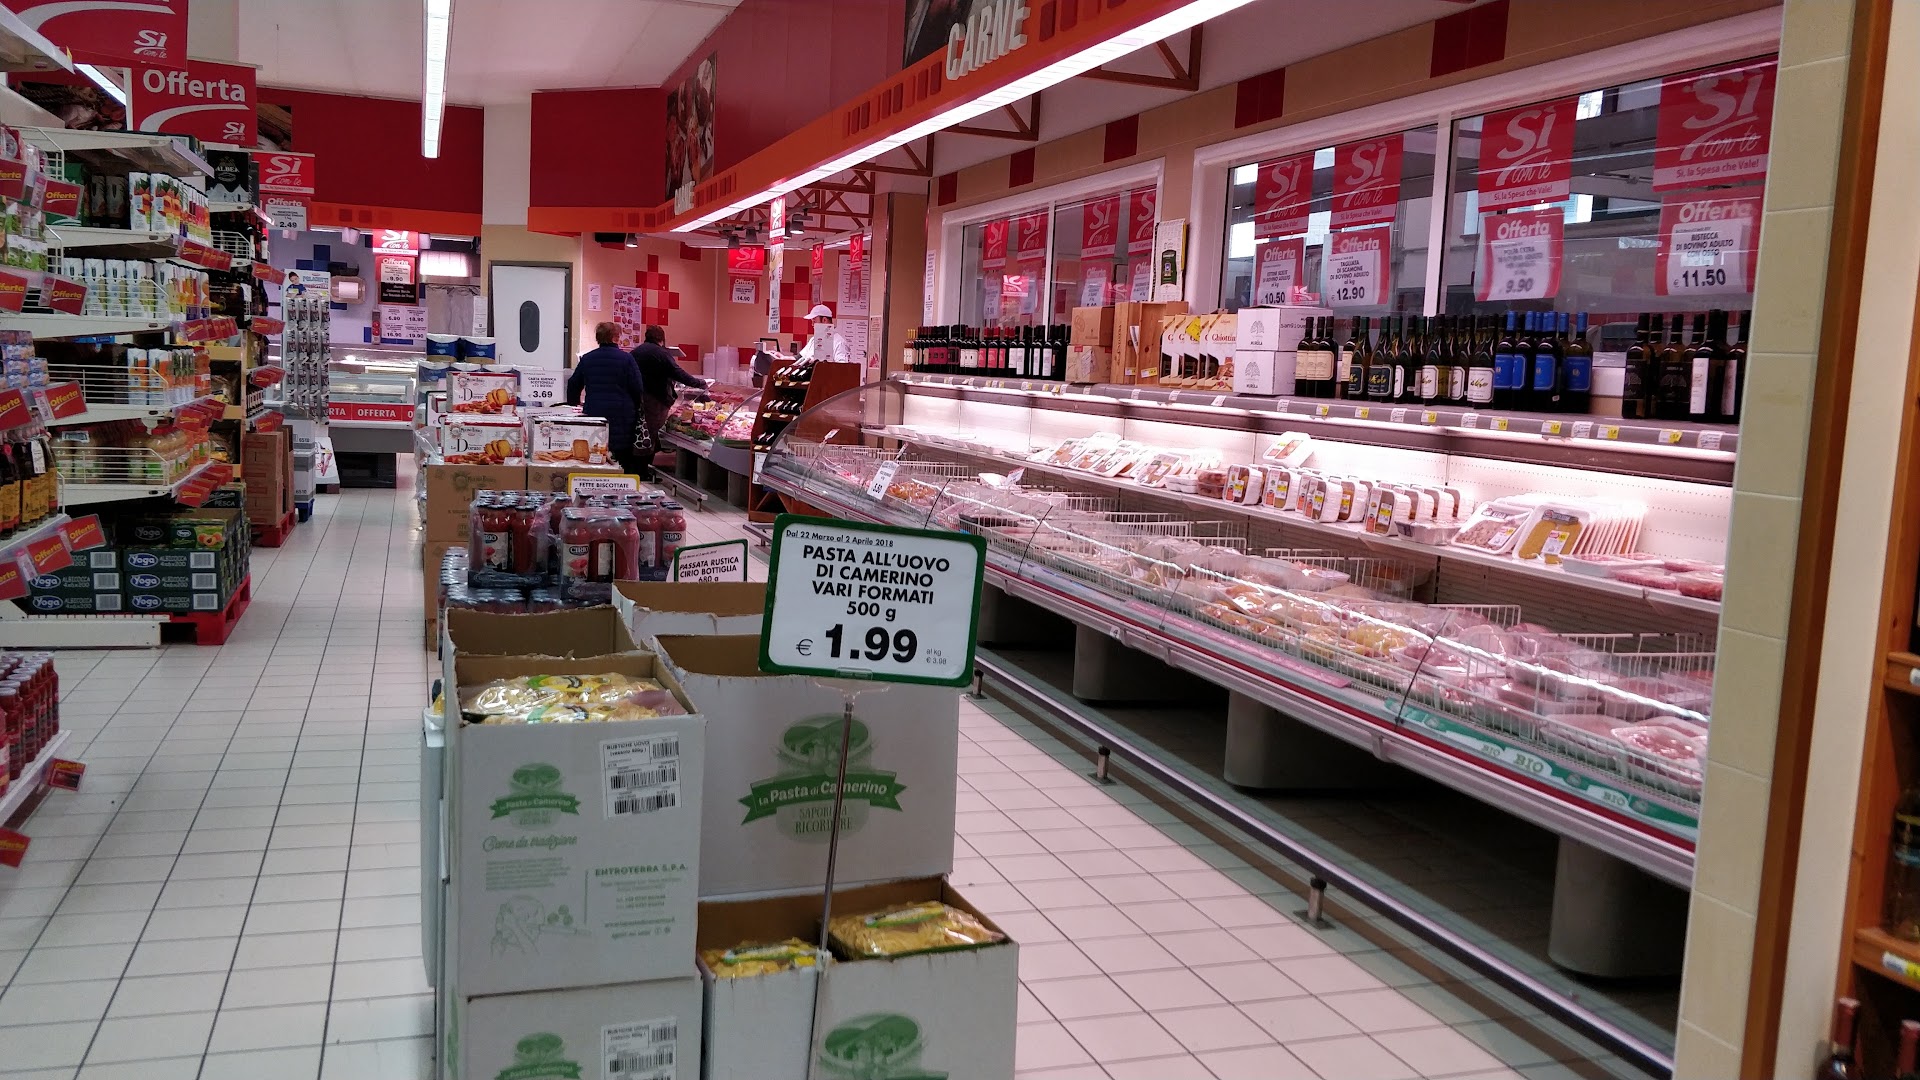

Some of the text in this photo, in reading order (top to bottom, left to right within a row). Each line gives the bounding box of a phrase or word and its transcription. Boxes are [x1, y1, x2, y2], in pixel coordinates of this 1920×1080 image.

[945, 0, 1030, 80] CARNE
[143, 69, 246, 102] Offerta
[1687, 159, 1759, 178] la Spesa che Vale!
[46, 191, 78, 199] Offerta
[1501, 186, 1553, 201] la Spesa che Vale!
[268, 197, 303, 207] Offerta
[1350, 210, 1362, 220] Spesa
[1363, 209, 1371, 218] che
[1679, 201, 1753, 223] Offerta
[1497, 220, 1550, 239] Offerta
[1691, 232, 1719, 241] BISTECCA
[1340, 238, 1379, 252] Offerta
[1676, 239, 1734, 251] DI BOVINO ADULTO
[1264, 247, 1296, 261] Offerta
[1335, 272, 1352, 280] BOVINO
[1353, 271, 1369, 279] ADULTO
[1342, 265, 1363, 273] SCAMONE
[1682, 268, 1726, 287] 11.50
[1505, 278, 1534, 293] 9.90
[52, 290, 82, 299] Offerta
[1265, 291, 1286, 304] 10.50
[1336, 286, 1365, 301] 12.90
[50, 389, 78, 407] Offerta
[358, 408, 396, 418] OFFERTA
[69, 523, 96, 540] Offerta
[664, 533, 681, 541] CIRIO
[786, 530, 799, 538] Dal
[812, 532, 834, 541] Marzo
[852, 537, 873, 546] Aprile
[876, 538, 894, 547] 2018
[34, 542, 62, 563] Offerta
[570, 546, 589, 554] CIRIO
[130, 554, 156, 567] Yoga
[679, 556, 739, 570] PASSATA RUSTICA
[803, 544, 950, 572] PASTA ALL'UOVO
[680, 564, 737, 578] CIRIO BOTTIGLIA
[816, 563, 934, 588] DI CAMERINO
[32, 575, 59, 588] Yoga
[132, 575, 159, 588] Yoga
[812, 581, 934, 605] VARI FORMATI
[34, 597, 61, 609] Yoga
[133, 596, 160, 608] Yoga
[846, 601, 896, 622] 500 g
[796, 624, 918, 663] € 1.99
[933, 649, 942, 657] kg
[1482, 744, 1501, 757] BIO
[1513, 754, 1544, 773] BIO
[758, 796, 769, 806] La
[770, 786, 808, 803] Pasta
[810, 786, 819, 795] di
[1603, 790, 1626, 807] BIO
[482, 834, 578, 852] Come da tradizione
[595, 864, 689, 877] ENTROTERRA S.P.A.
